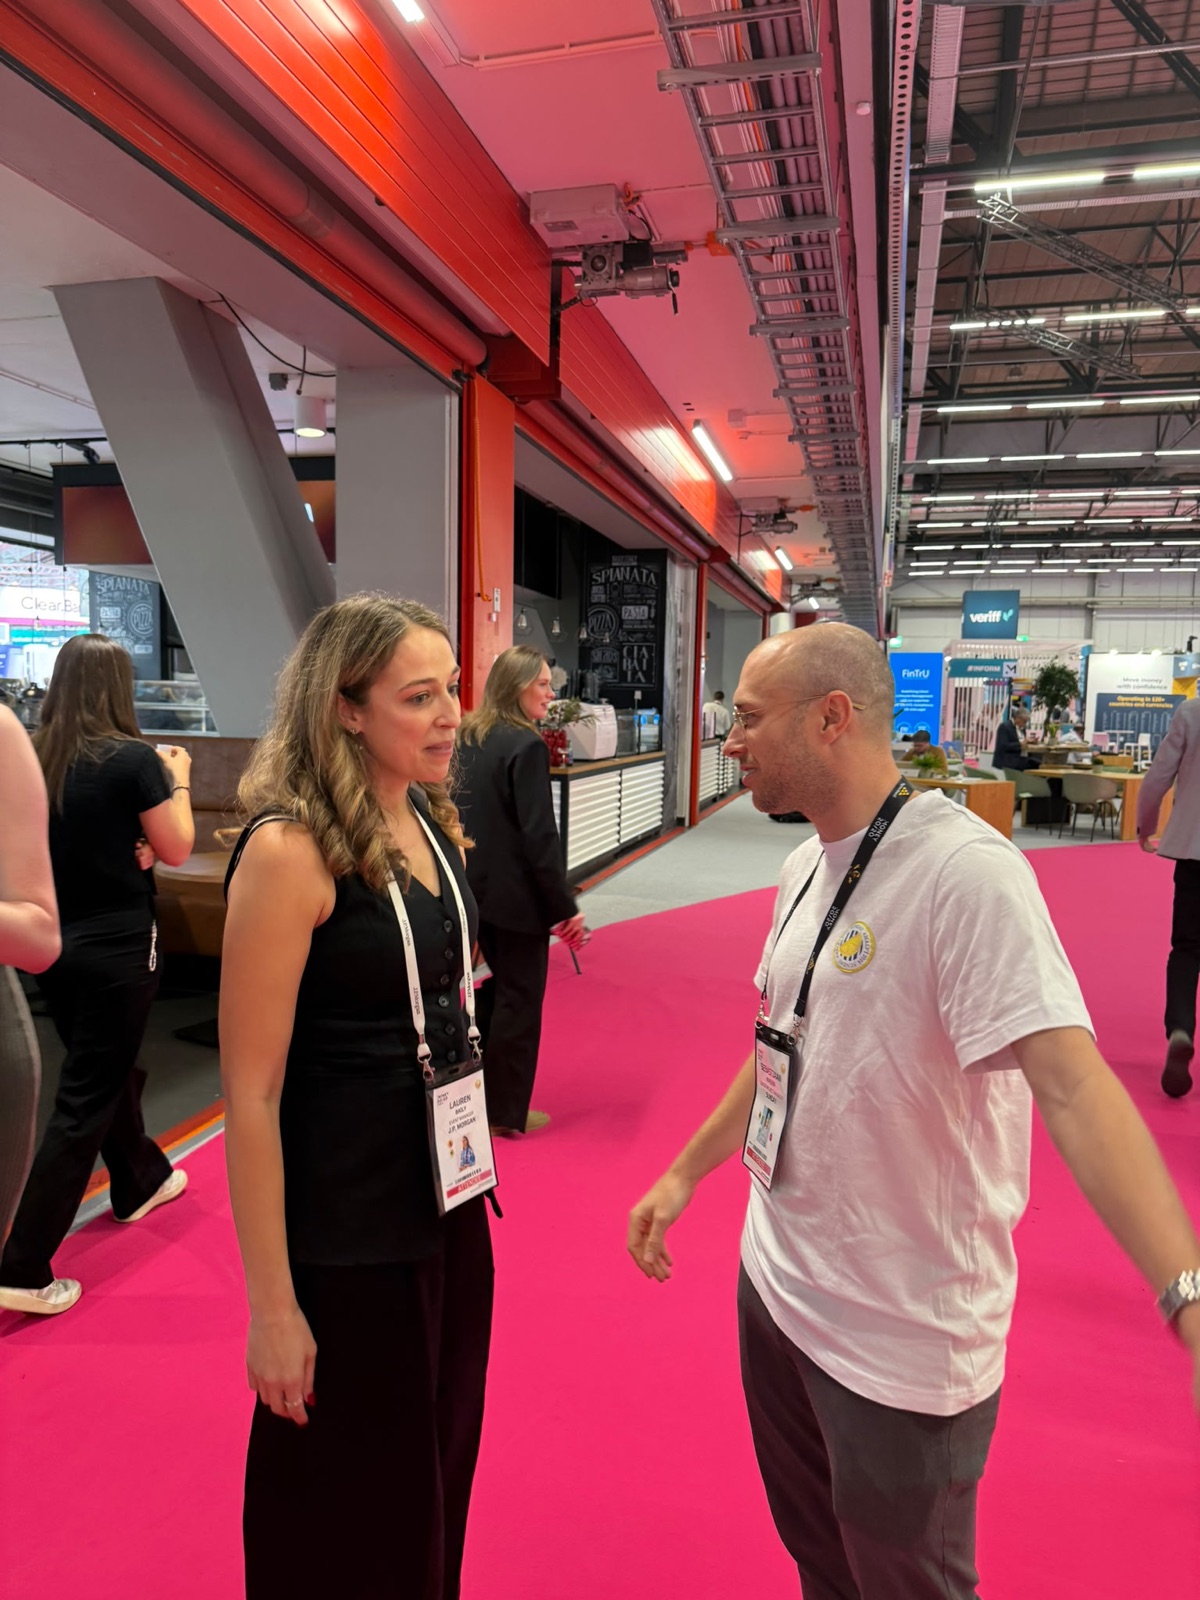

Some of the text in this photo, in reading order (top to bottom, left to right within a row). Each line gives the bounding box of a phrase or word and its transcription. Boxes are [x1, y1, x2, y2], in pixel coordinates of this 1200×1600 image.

[592, 566, 657, 585] SPIANATA
[98, 577, 150, 595] SPIANATA
[623, 606, 647, 619] PASTA
[969, 610, 1002, 623] veriff
[589, 613, 612, 629] PIZZA
[902, 669, 930, 678] FinTrU
[868, 817, 884, 838] 20/20
[873, 819, 890, 842] MONEY
[449, 1094, 472, 1110] LAUREN
[457, 1116, 477, 1130] MORGAN
